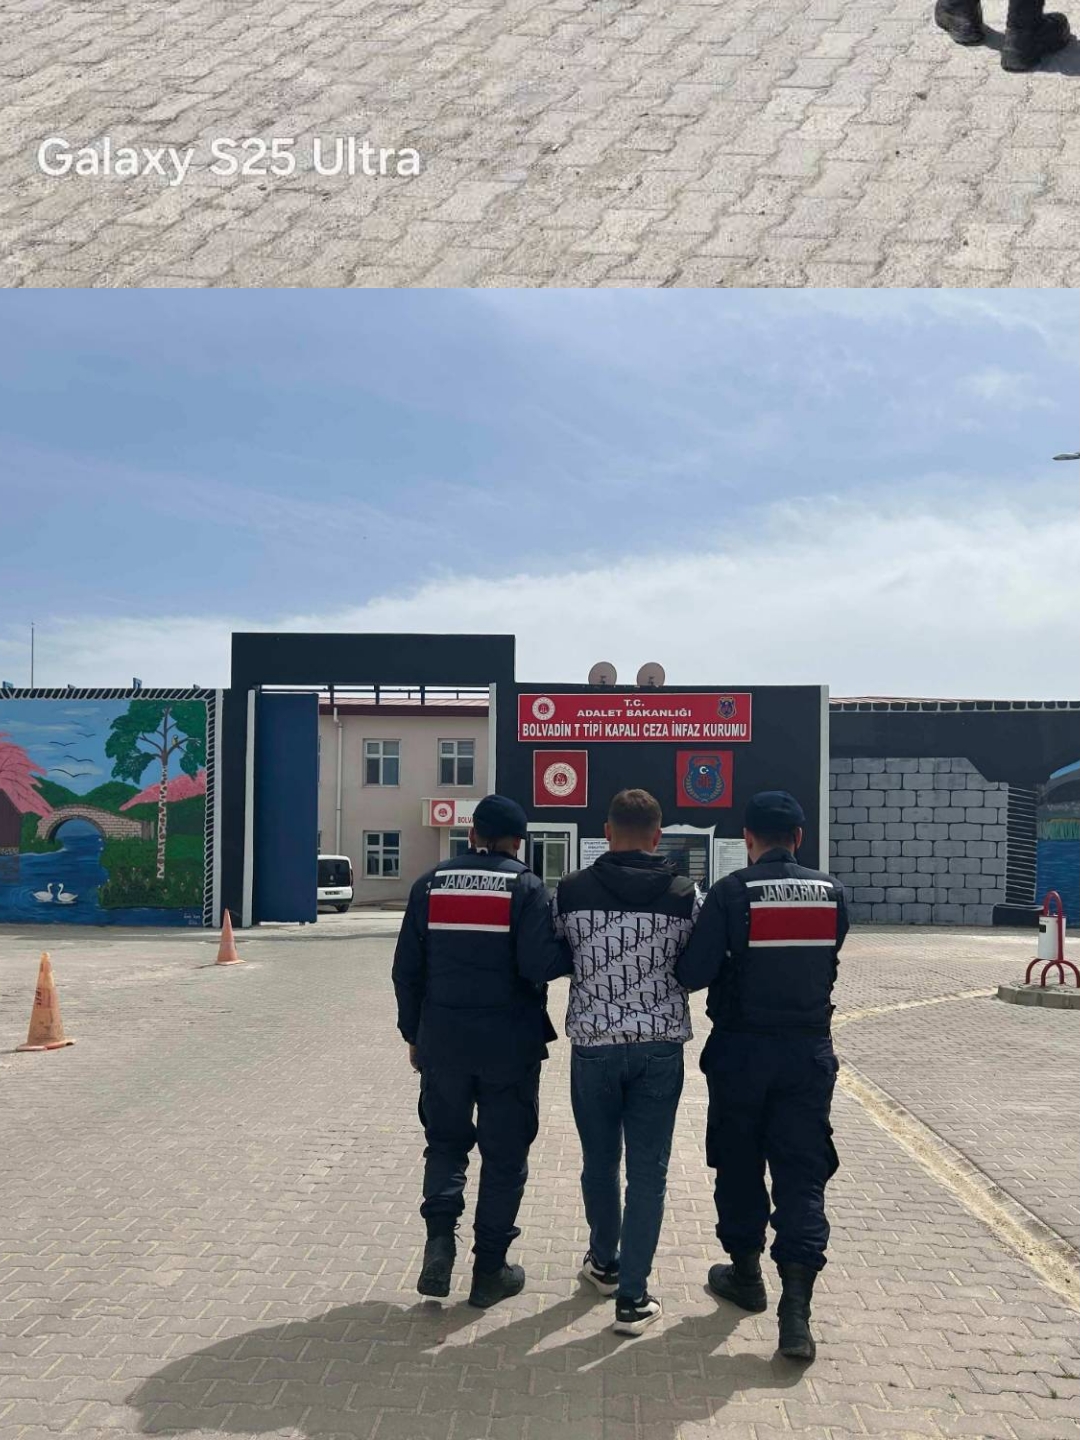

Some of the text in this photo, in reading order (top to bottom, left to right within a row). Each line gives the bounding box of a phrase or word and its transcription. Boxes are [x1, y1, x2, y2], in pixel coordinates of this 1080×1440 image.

[624, 699, 645, 707] T.C.
[577, 708, 691, 717] ADALET BAKANLIĞI
[522, 720, 747, 737] BOLVADİN T TİPİ KAPALI CEZA İNFAZ KURUMU
[440, 875, 507, 891] JANDARMA
[760, 884, 829, 902] JANDARMA
